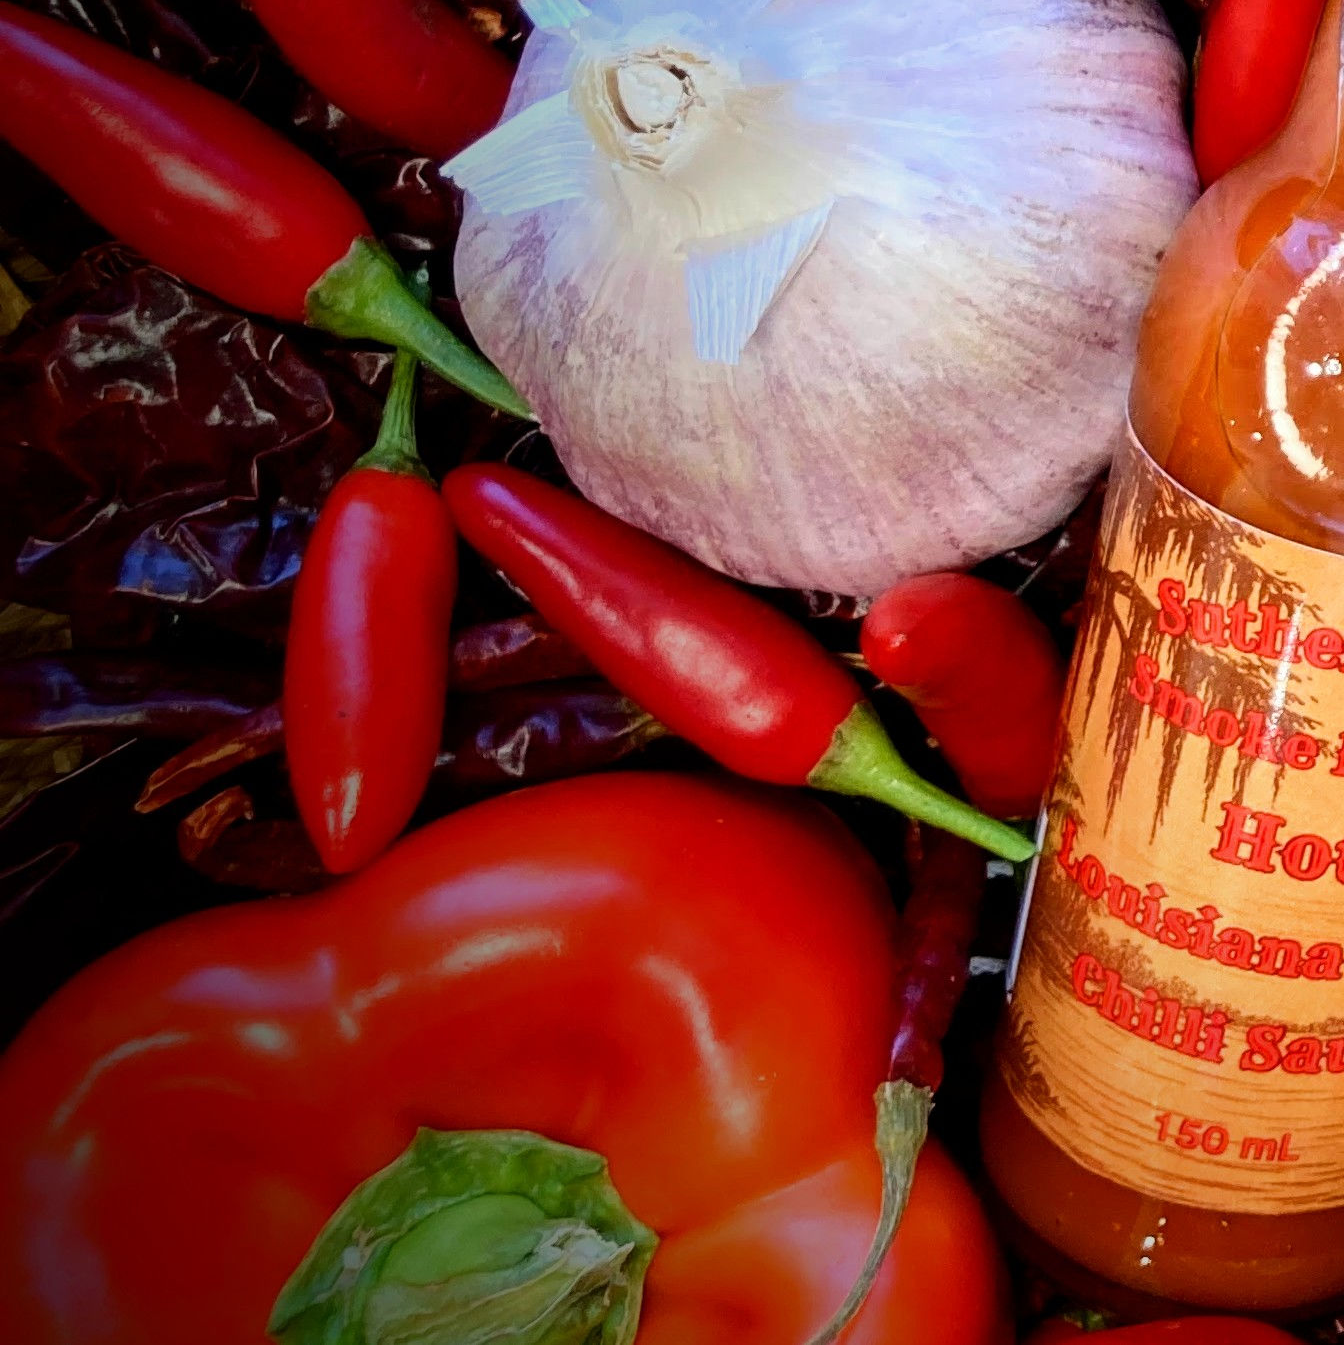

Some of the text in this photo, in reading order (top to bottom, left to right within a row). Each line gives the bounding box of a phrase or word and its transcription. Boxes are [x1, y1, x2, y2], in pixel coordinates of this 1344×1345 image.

[1128, 655, 1320, 771] Smoke
[1057, 815, 1344, 981] Louisiana
[1072, 952, 1228, 1063] Chilli
[1153, 1112, 1300, 1162] 150 mL
